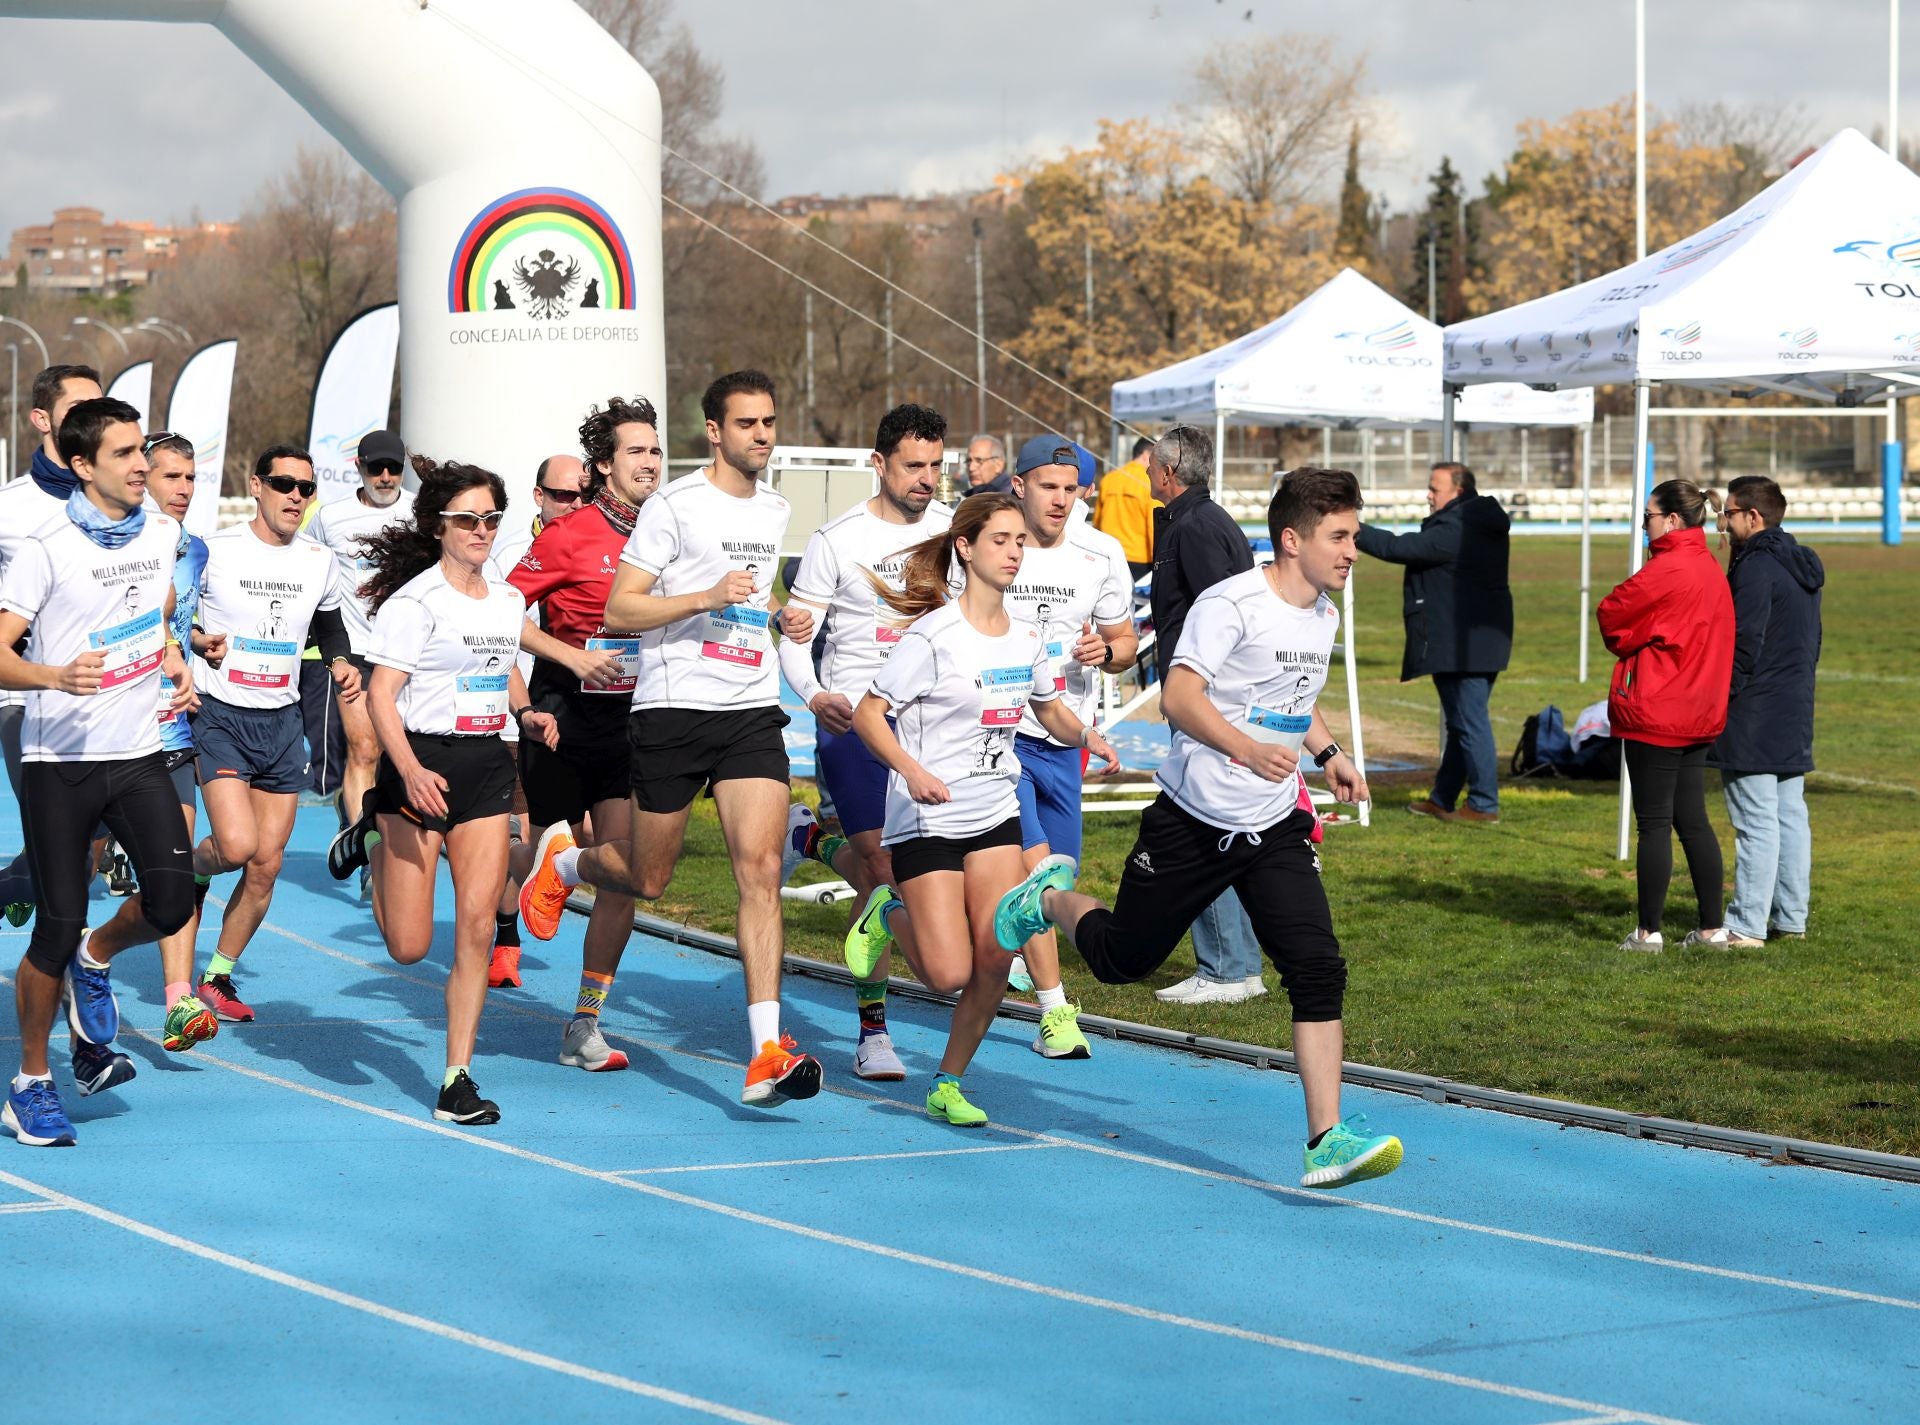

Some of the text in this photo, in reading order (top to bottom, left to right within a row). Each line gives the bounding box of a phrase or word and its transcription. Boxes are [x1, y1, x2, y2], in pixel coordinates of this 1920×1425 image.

[449, 326, 640, 345] CONCEJALIA DE DEPORTES
[1343, 355, 1434, 367] TOLEDO
[1659, 351, 1703, 361] TOLEDO
[1777, 351, 1819, 360] TOLEDO
[722, 541, 776, 554] MILLA HOMENAJE
[91, 558, 162, 580] MILLA HOMENAJE
[102, 578, 126, 588] MARTIN
[239, 579, 304, 593] MILLA HOMENAJE
[247, 590, 298, 599] MARTIN VELASCO
[1004, 584, 1077, 598] MILLA HOMENAJE
[1039, 595, 1069, 604] VELASCO
[712, 620, 735, 631] IDAFE
[463, 635, 486, 646] MILLA
[736, 637, 749, 648] 38
[108, 644, 122, 655] OSE
[718, 645, 756, 660] SOLISS
[127, 650, 142, 663] 53
[1275, 650, 1329, 666] MILLA HOMENAJE
[114, 654, 158, 679] SOLISS
[258, 664, 270, 673] 71
[242, 673, 282, 684] SOLISS
[991, 686, 1003, 695] ANA
[1011, 697, 1022, 708] 46
[486, 704, 497, 714] 70
